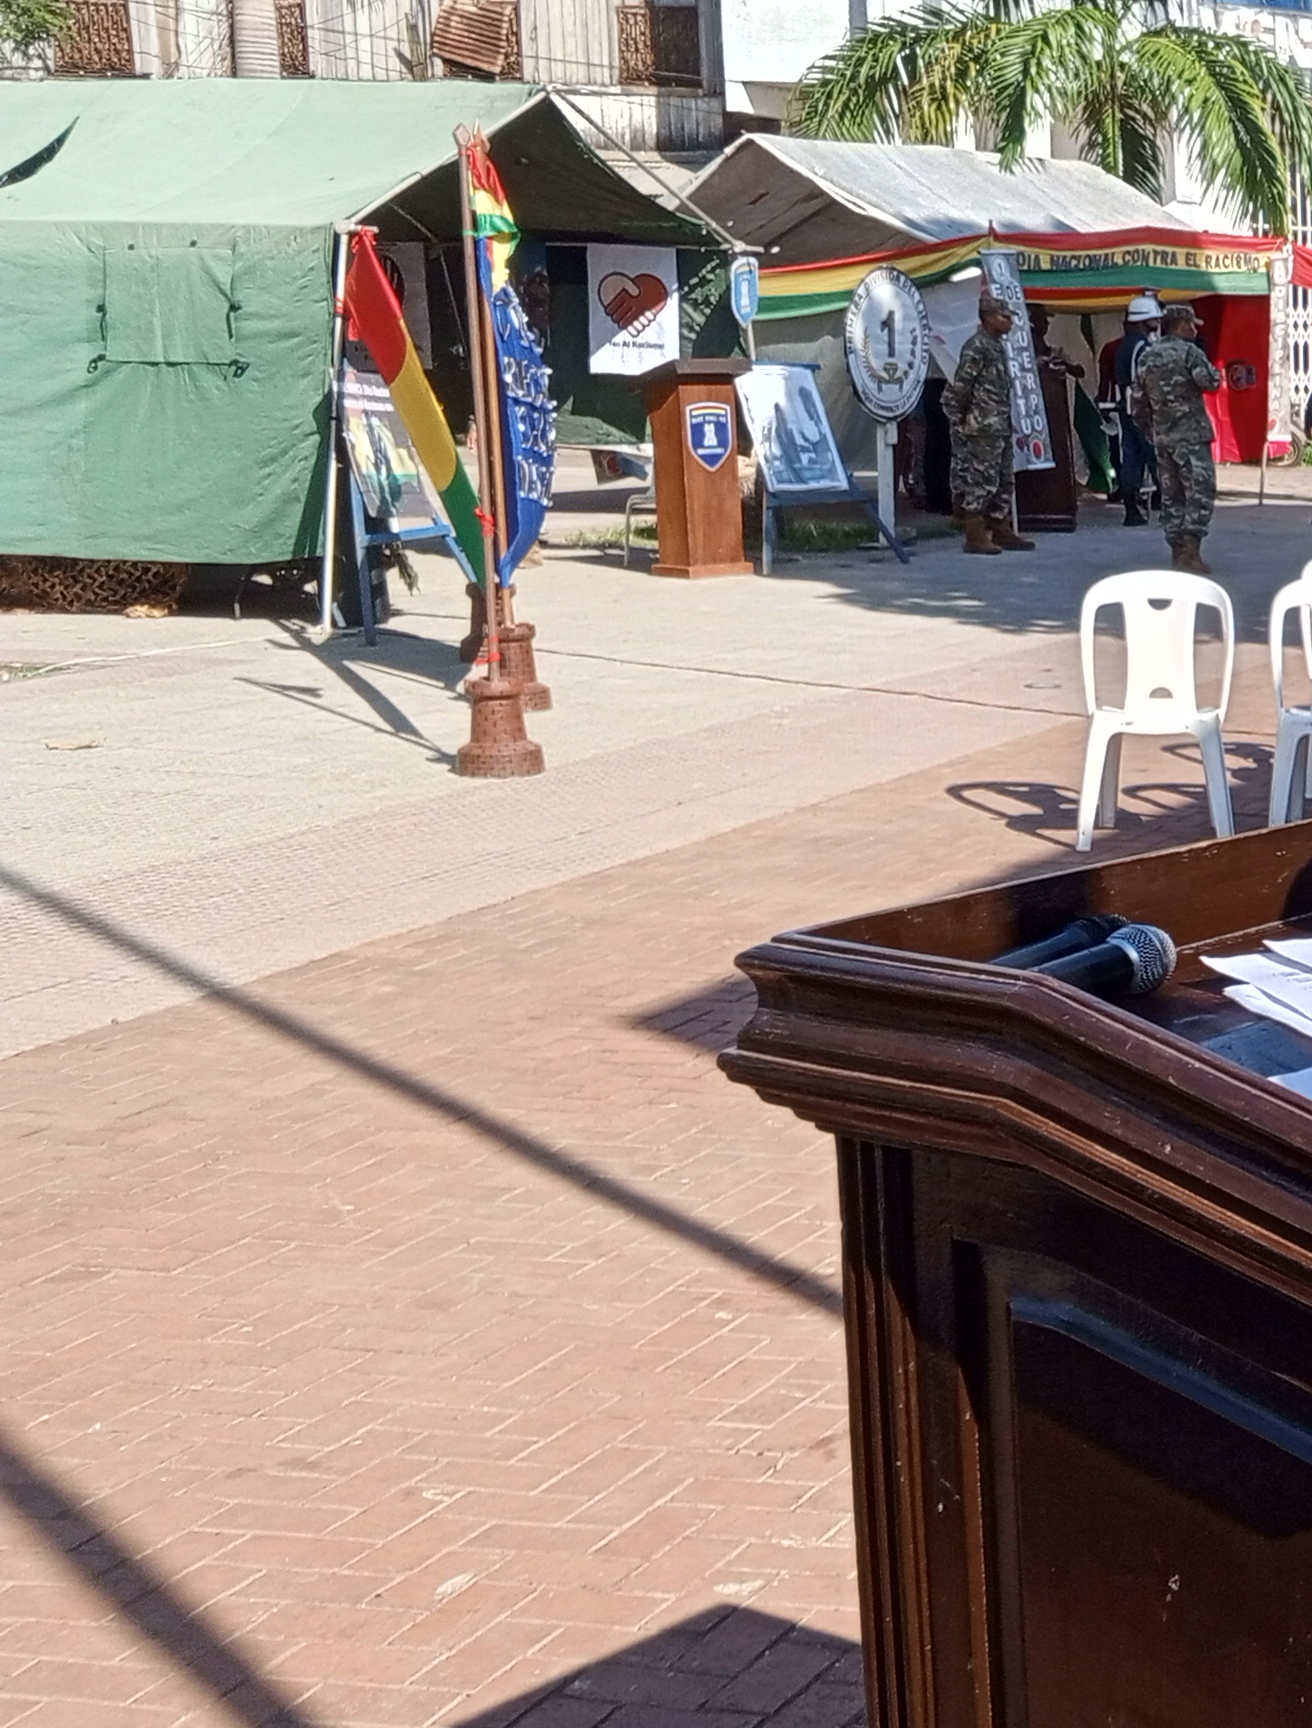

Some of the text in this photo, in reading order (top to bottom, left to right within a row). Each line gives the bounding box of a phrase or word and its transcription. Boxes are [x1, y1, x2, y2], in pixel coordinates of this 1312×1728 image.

[1050, 252, 1119, 272] NACIONAL
[1122, 248, 1178, 267] CONTRA
[1185, 251, 1200, 268] EL
[1205, 253, 1260, 273] RACISMO
[880, 310, 896, 358] 1
